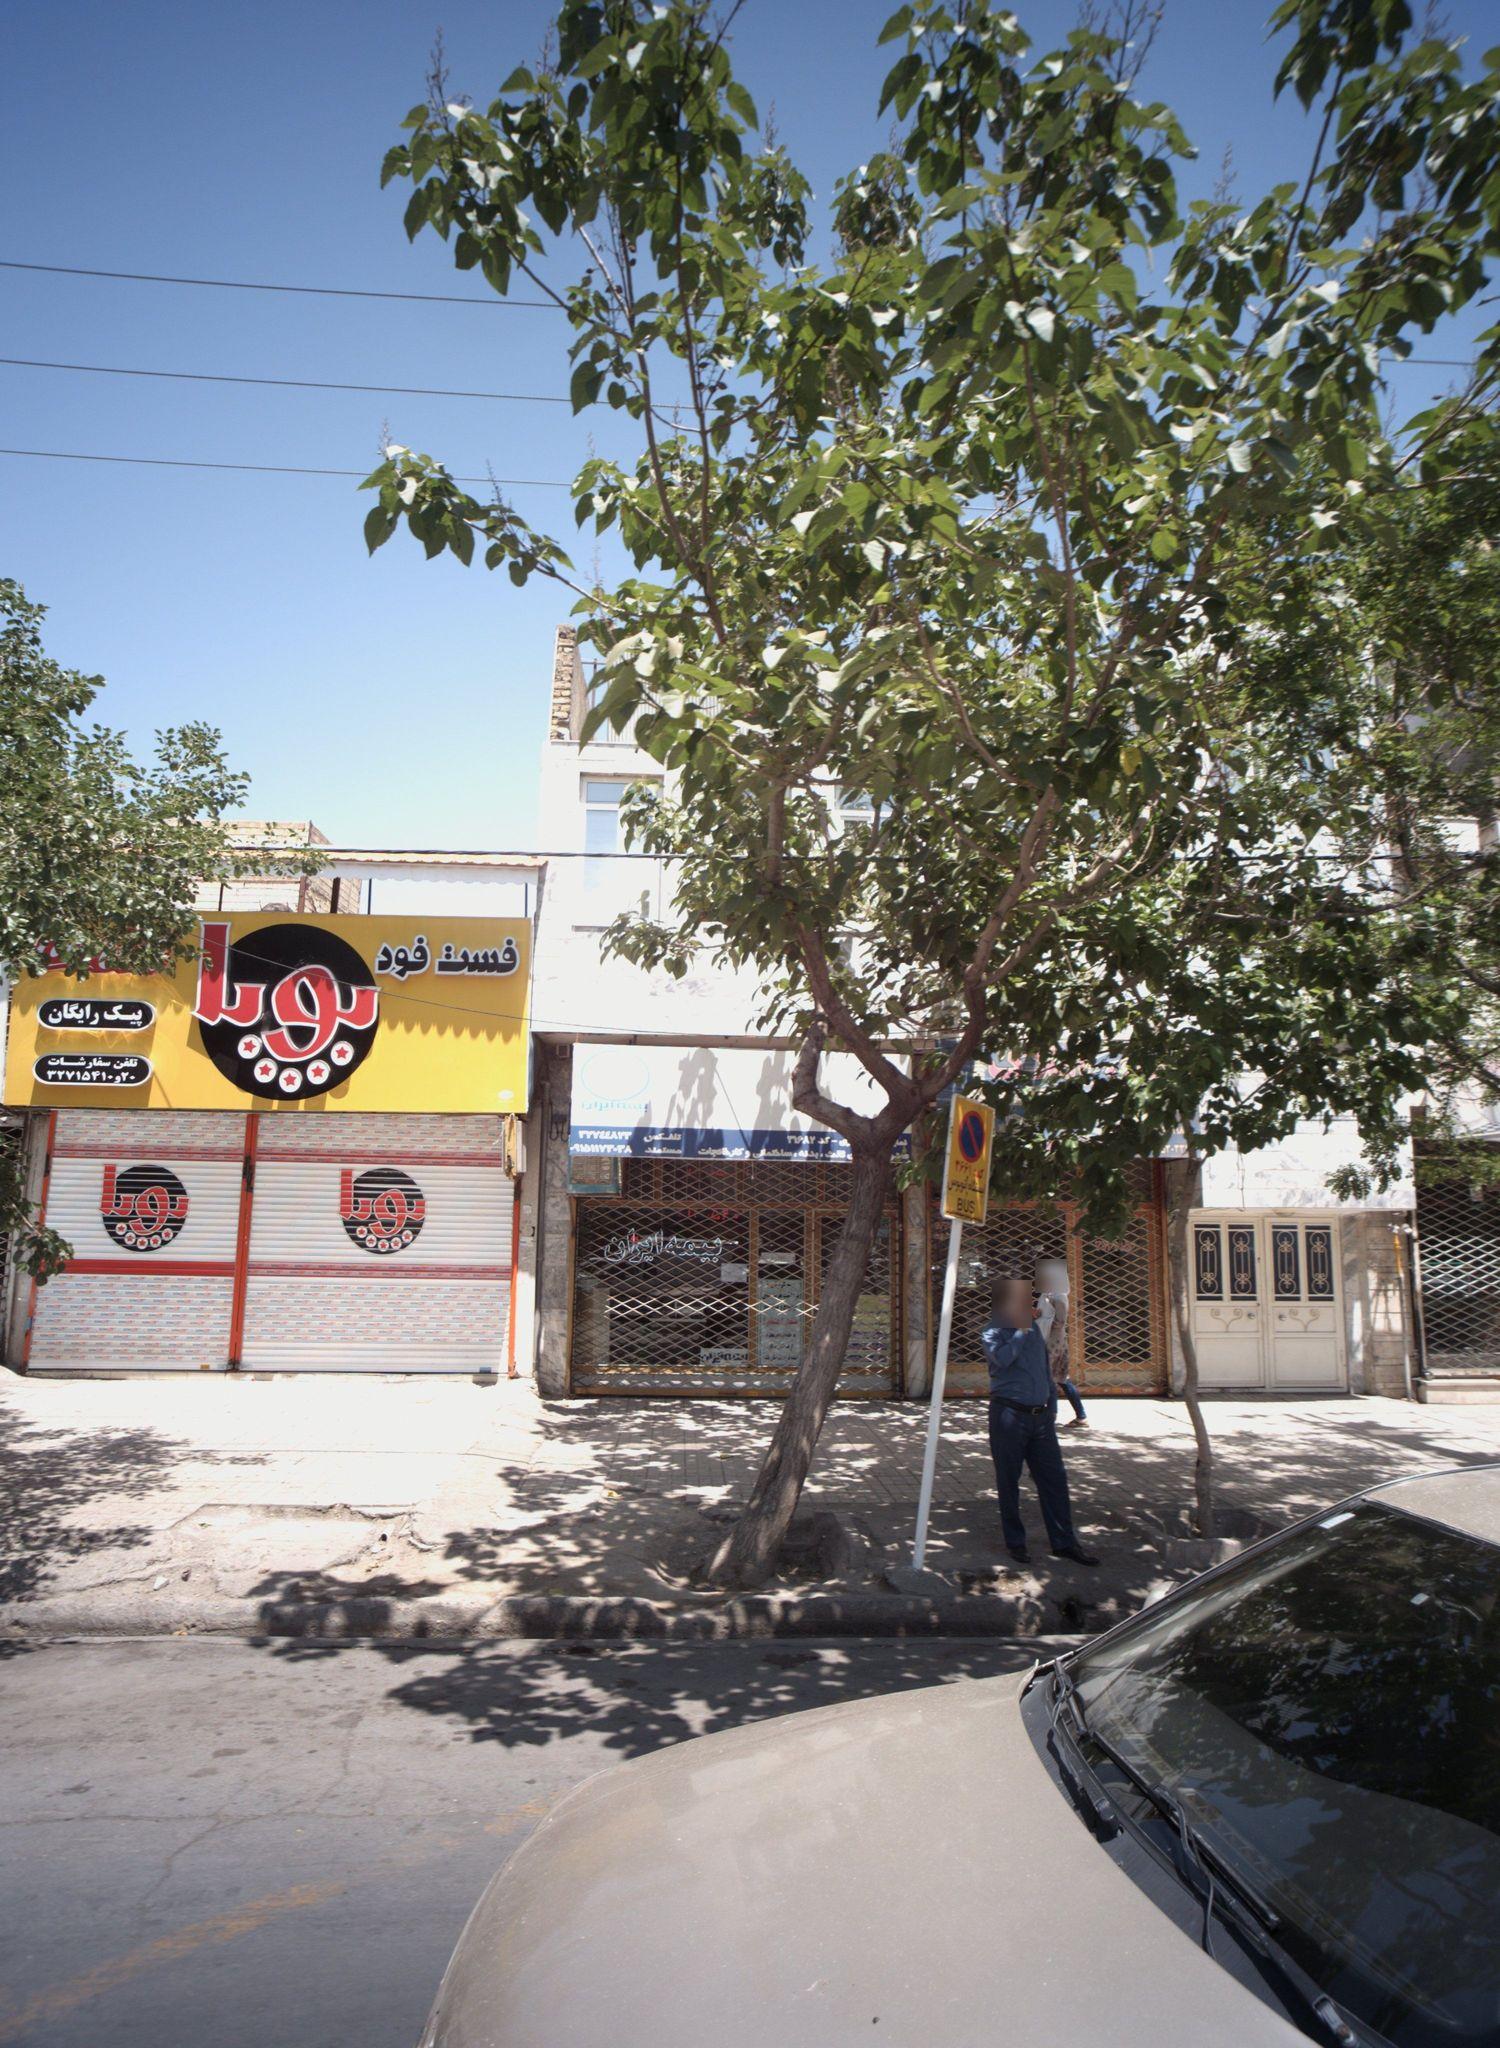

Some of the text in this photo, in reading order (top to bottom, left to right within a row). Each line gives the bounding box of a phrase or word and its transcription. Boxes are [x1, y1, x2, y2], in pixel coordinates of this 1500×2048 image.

[375, 935, 520, 981] فست فود
[48, 1003, 142, 1026] پیک رایگان
[47, 1057, 138, 1069] تلفن سفارشات
[957, 1198, 976, 1214] BUS
[604, 1227, 723, 1264] بیمه ایران
